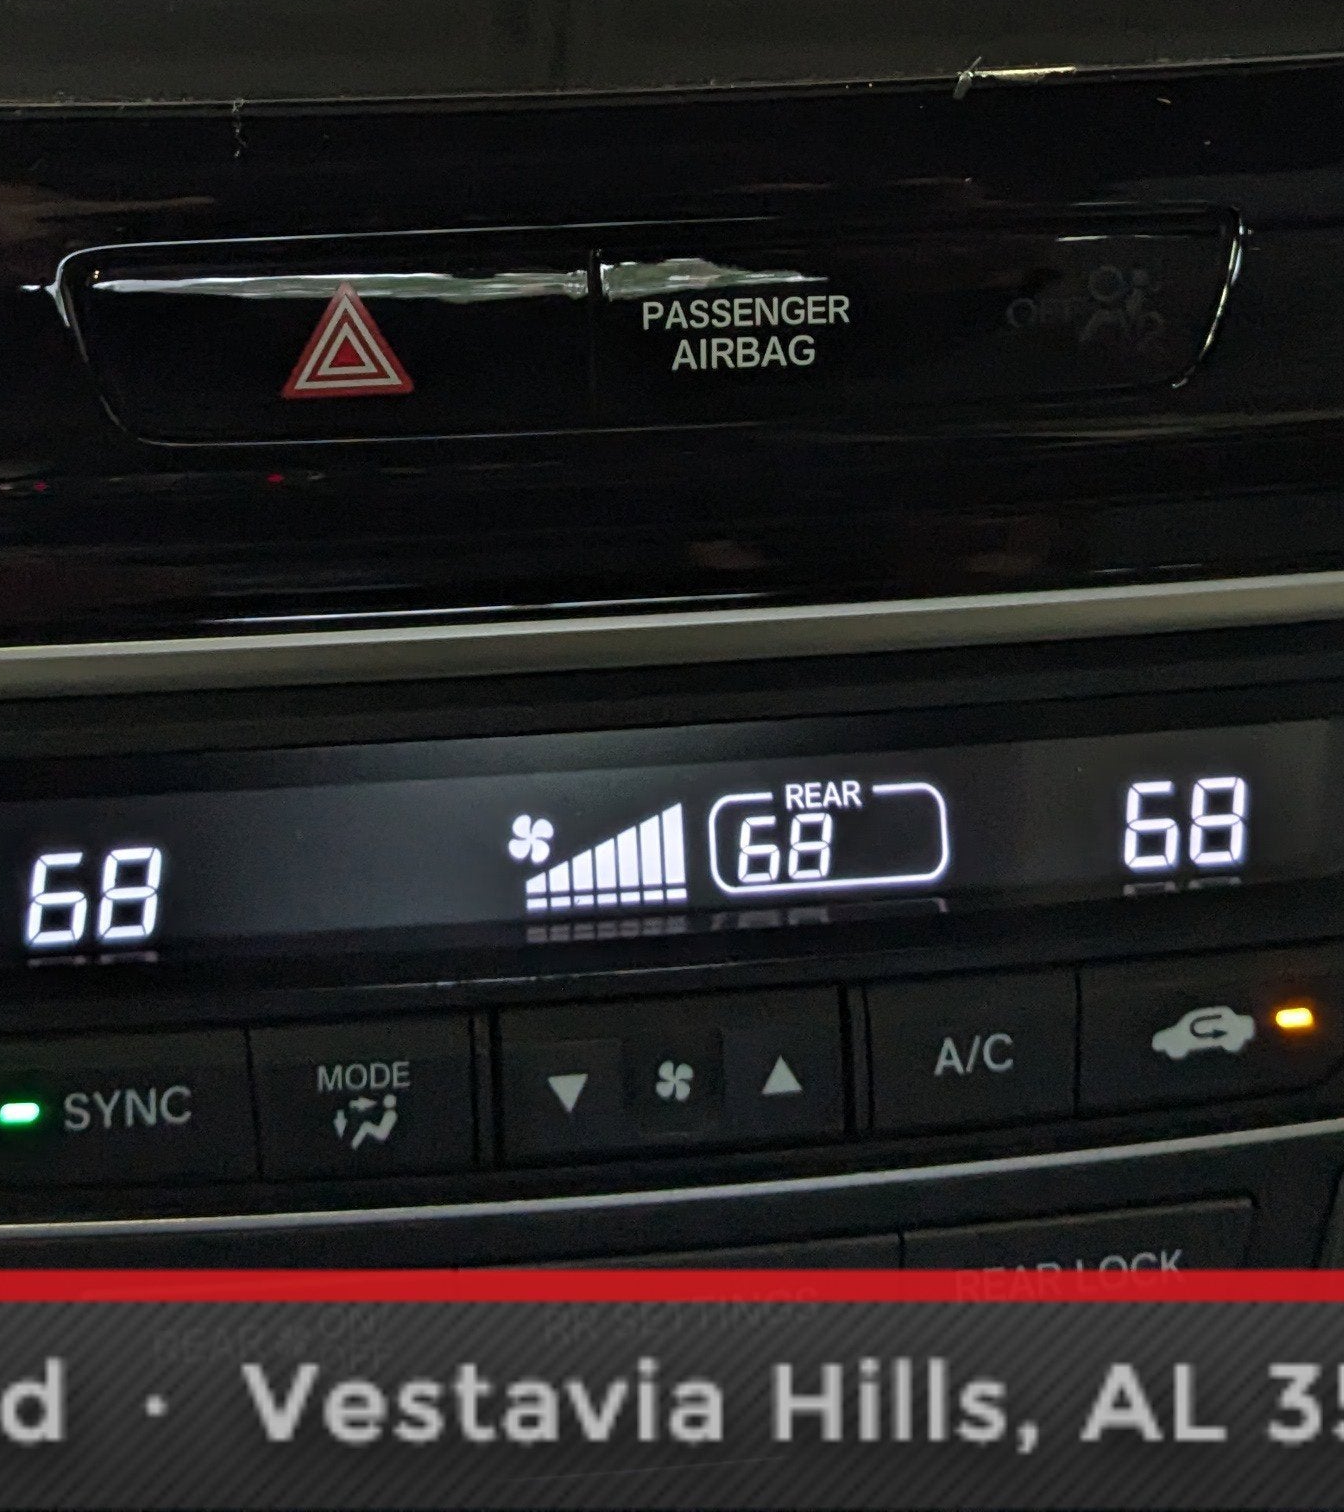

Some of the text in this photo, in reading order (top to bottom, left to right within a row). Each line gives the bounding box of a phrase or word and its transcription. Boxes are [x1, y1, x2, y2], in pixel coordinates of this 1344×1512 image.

[642, 295, 851, 331] PASSENGER
[672, 335, 816, 371] AIRBAG
[785, 779, 863, 811] REAR
[1122, 776, 1247, 872] 68
[737, 813, 834, 884] 68
[25, 846, 163, 948] 68
[934, 1033, 1014, 1076] A/C
[316, 1061, 411, 1092] MODE
[64, 1085, 193, 1131] SYNC
[1074, 1247, 1184, 1290] LOCK
